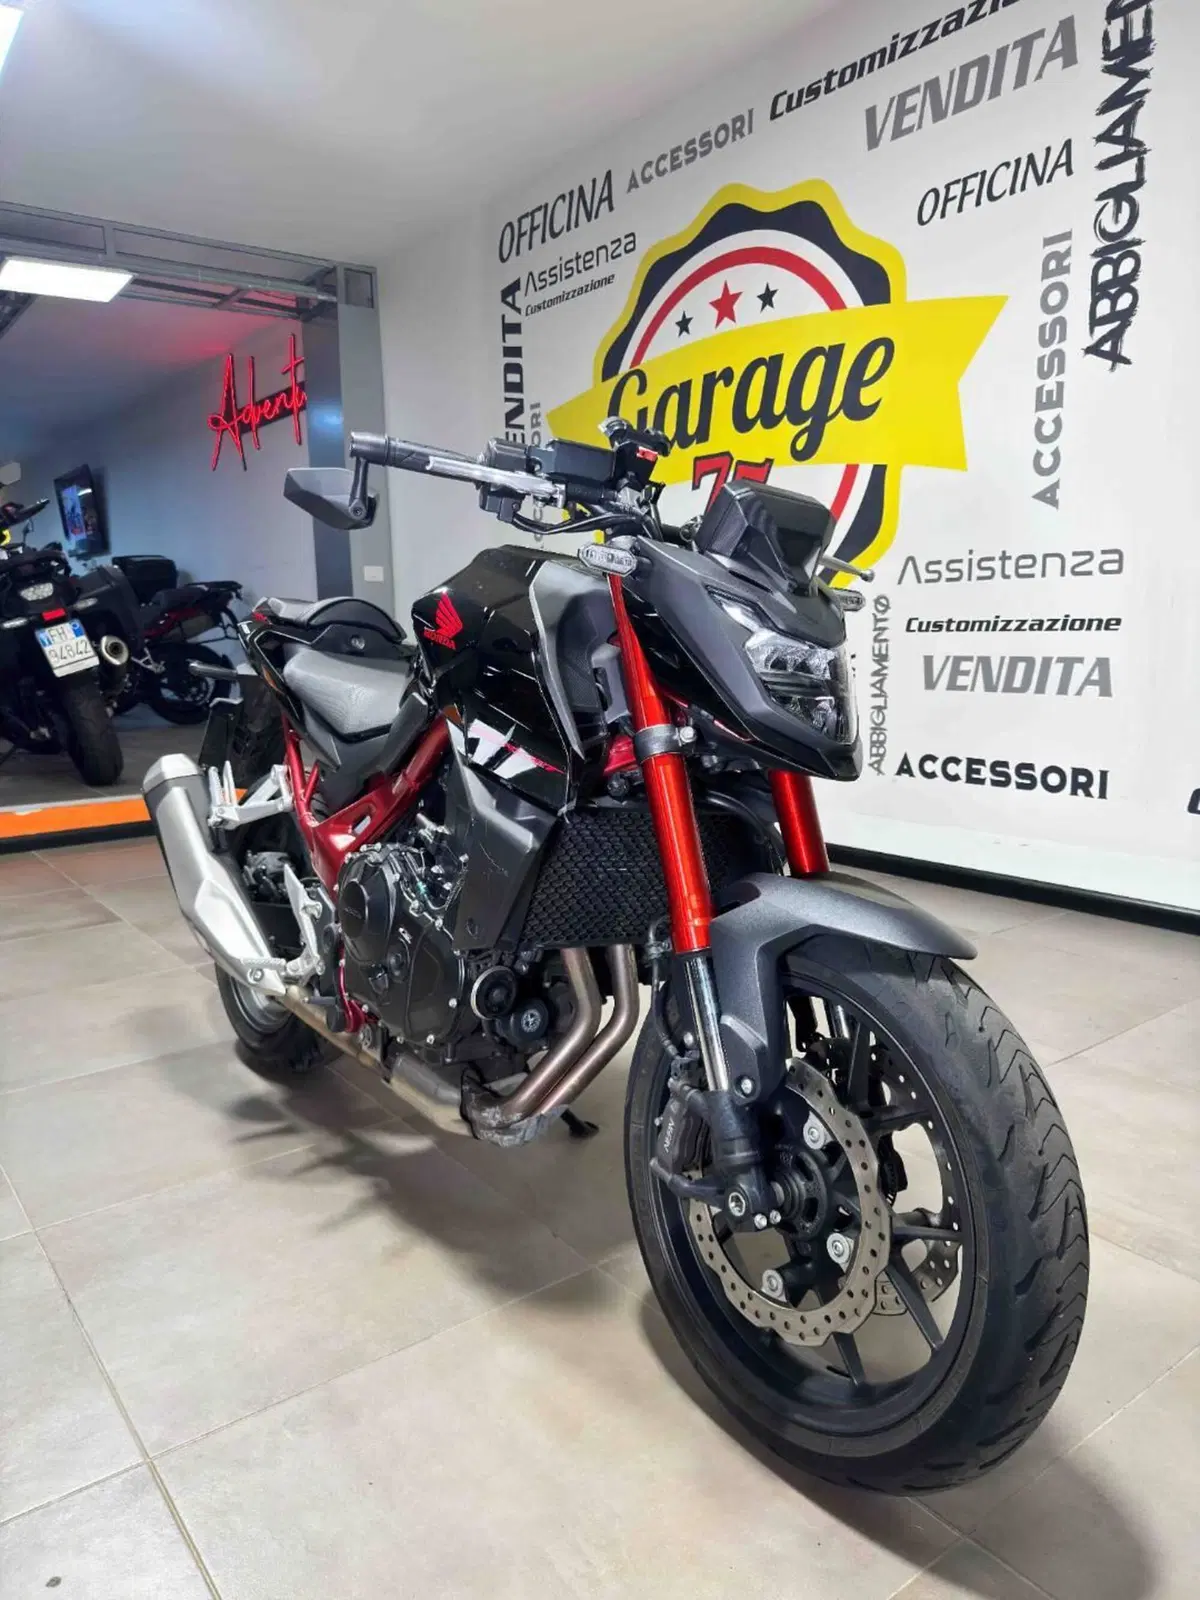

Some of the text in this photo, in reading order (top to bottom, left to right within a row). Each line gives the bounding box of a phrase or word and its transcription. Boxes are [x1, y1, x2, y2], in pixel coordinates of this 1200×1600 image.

[865, 15, 1079, 151] VENDITA
[627, 108, 754, 194] ACCESSORI
[917, 138, 1074, 227] OFFICINA
[498, 170, 615, 264] OFFICINA
[525, 232, 637, 297] Assistenza
[525, 274, 616, 317] Customizzazione
[500, 277, 525, 446] ENDITA
[1032, 229, 1073, 510] ACCESSORI
[607, 337, 895, 462] Garage
[898, 548, 1124, 585] Assistenza
[423, 626, 457, 650] HONDA
[905, 614, 1122, 633] Customizzazione
[922, 654, 1113, 698] VENDITA
[895, 752, 1110, 800] ACCESSORI
